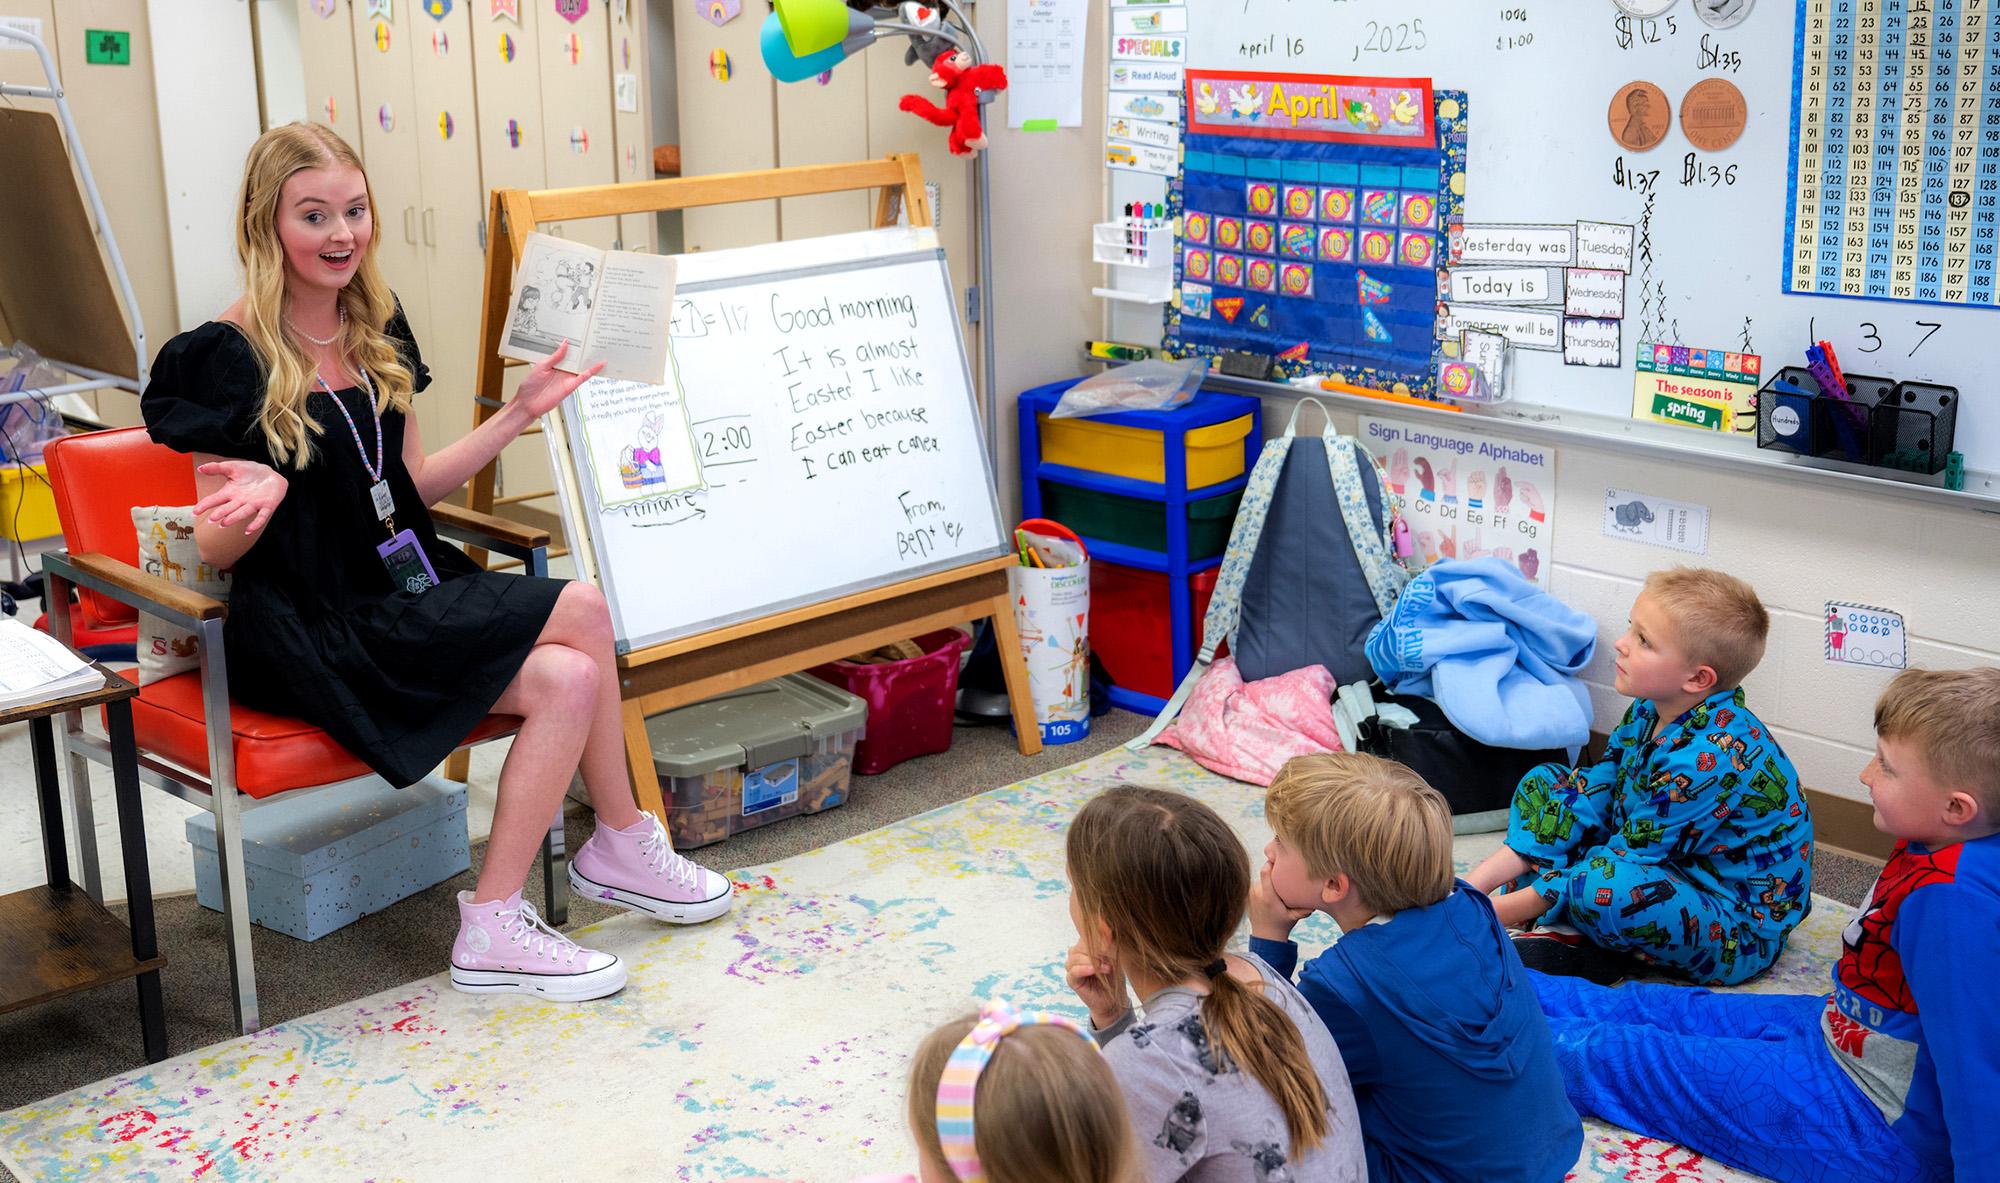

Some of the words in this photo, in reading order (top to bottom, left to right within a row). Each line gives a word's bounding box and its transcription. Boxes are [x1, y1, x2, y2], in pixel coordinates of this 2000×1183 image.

[1118, 38, 1181, 57] SPECIALS
[1239, 34, 1274, 58] April
[1286, 37, 1304, 57] 16
[1697, 33, 1742, 73] $1.35
[1131, 71, 1152, 80] Read
[1155, 71, 1177, 80] Aloud
[1809, 81, 1820, 92] 61
[1832, 81, 1846, 92] 62
[1857, 81, 1871, 92] 63
[1883, 81, 1897, 92] 64
[1908, 81, 1923, 92] 65
[1935, 81, 1950, 92] 66
[1962, 81, 1977, 92] 67
[1267, 82, 1338, 127] April
[1136, 126, 1169, 144] Writing
[1807, 128, 1817, 138] 91
[1830, 128, 1843, 138] 92
[1855, 128, 1869, 139] 93
[1880, 129, 1894, 139] 94
[1906, 129, 1920, 140] 95
[1931, 129, 1946, 140] 96
[1958, 130, 1973, 141] 97
[1985, 130, 2000, 142] 98
[1613, 156, 1660, 194] $1.37
[1680, 152, 1738, 187] $1.36
[1803, 173, 1816, 184] 121
[1826, 174, 1842, 185] 122
[1851, 175, 1867, 186] 123
[1876, 176, 1892, 187] 124
[1901, 176, 1918, 188] 125
[1926, 177, 1944, 188] 126
[1953, 178, 1970, 189] 127
[1980, 179, 1998, 191] 128
[1258, 191, 1265, 208] 1
[1294, 195, 1304, 211] 2
[1332, 198, 1342, 213] 3
[1413, 203, 1423, 219] 5
[1224, 227, 1231, 239] 7
[1327, 237, 1345, 253] 10
[1369, 239, 1384, 256] 11
[1409, 242, 1425, 259] 12
[1462, 237, 1532, 256] Yesterday
[1539, 243, 1567, 254] was
[1582, 239, 1630, 258] Tuesday
[1223, 264, 1235, 279] 14
[1254, 268, 1267, 284] 15
[1288, 272, 1302, 288] 16
[1462, 276, 1513, 297] Today
[1521, 278, 1534, 293] is
[1568, 286, 1622, 302] Wednesday
[1797, 279, 1810, 290] 191
[1819, 281, 1836, 292] 192
[1844, 283, 1860, 294] 193
[1868, 284, 1885, 295] 194
[1894, 286, 1911, 297] 195
[1919, 287, 1937, 299] 196
[1945, 289, 1963, 300] 197
[1972, 291, 1990, 302] 198
[771, 293, 834, 333] Good
[1450, 314, 1509, 332] Tomorrow
[1515, 321, 1535, 335] will
[1539, 325, 1554, 337] be
[1567, 335, 1616, 351] Thursday
[1857, 322, 1883, 353] 3
[1908, 320, 1942, 358] 7
[772, 346, 812, 377] It
[827, 348, 847, 369] is
[856, 336, 919, 362] almost
[862, 368, 882, 392] I
[890, 366, 925, 387] like
[1449, 372, 1466, 388] 27
[609, 388, 625, 397] grass
[1656, 379, 1678, 393] The
[1681, 386, 1721, 400] season
[1724, 388, 1733, 401] is
[613, 409, 624, 417] you
[1667, 402, 1706, 423] spring
[1772, 415, 1800, 425] Hundreds
[791, 417, 853, 452] Easter
[863, 405, 929, 430] because
[1368, 422, 1400, 442] Sign
[1404, 428, 1474, 455] Language
[1479, 442, 1544, 467] Alphabet
[802, 455, 817, 480] I
[827, 450, 856, 470] can
[861, 443, 892, 463] eat
[1415, 500, 1432, 514] Cc
[1440, 504, 1457, 519] Dd
[1467, 510, 1484, 525] Ee
[1493, 515, 1507, 529] Ff
[1518, 520, 1537, 538] Gg
[151, 523, 168, 540] A
[146, 561, 161, 576] G
[197, 565, 212, 582] H
[151, 639, 167, 656] S
[1050, 723, 1072, 736] 105
